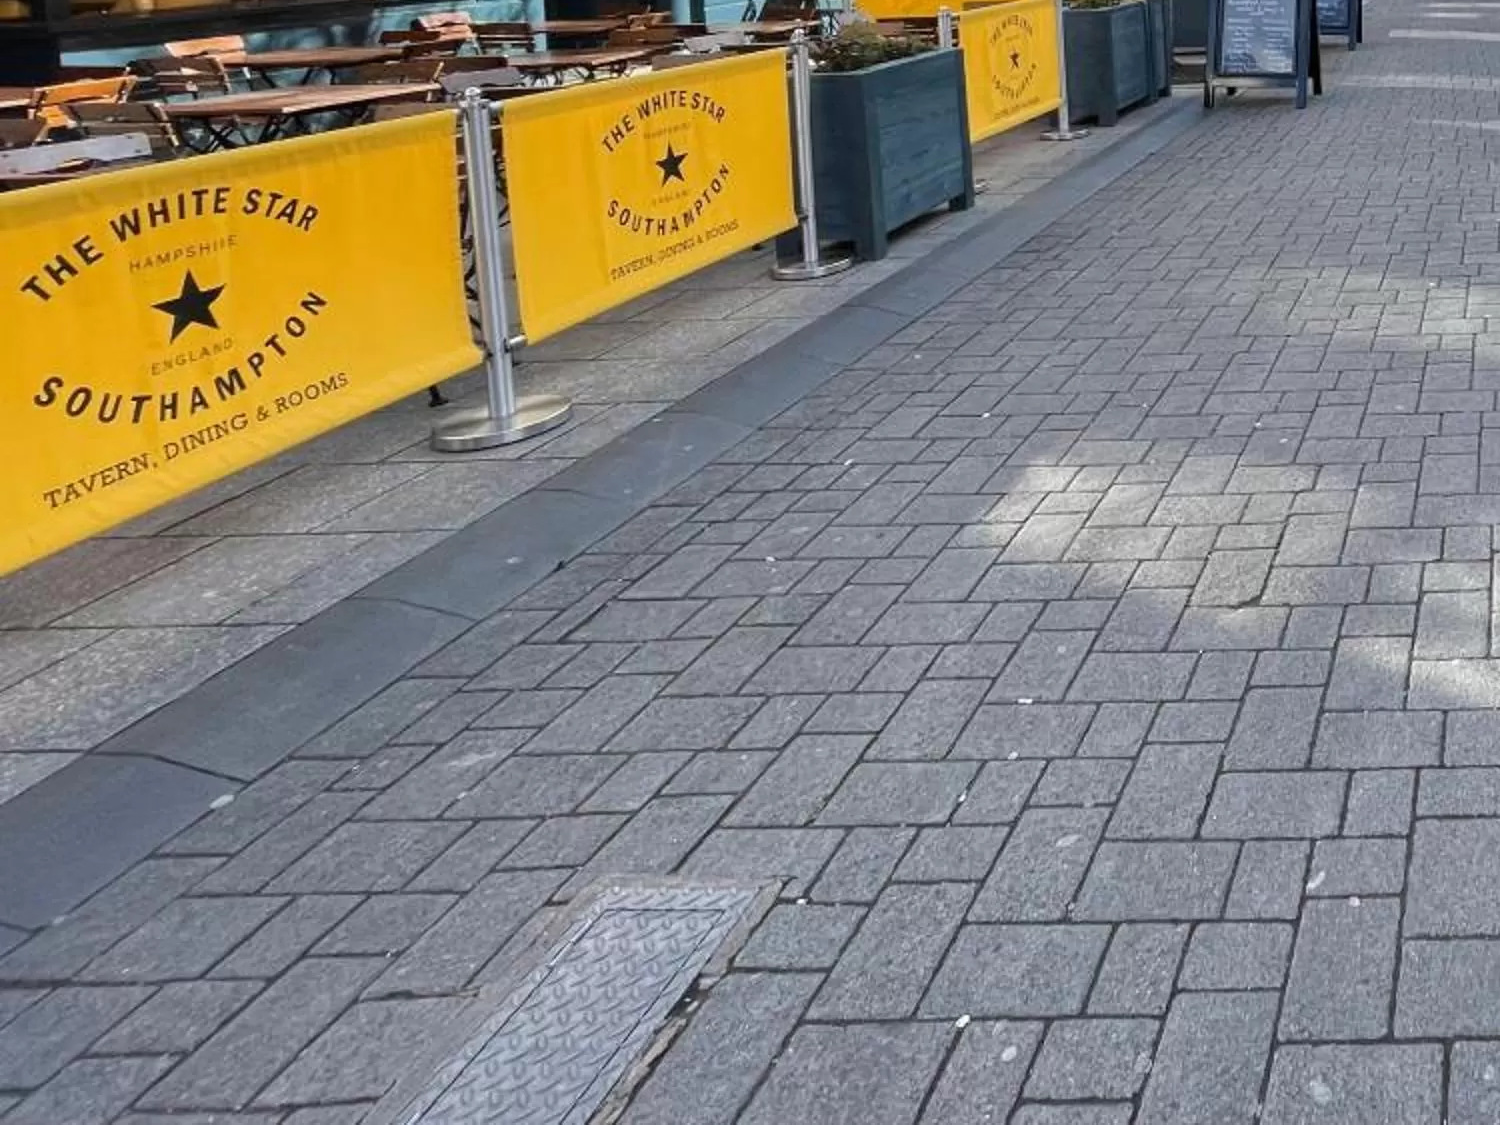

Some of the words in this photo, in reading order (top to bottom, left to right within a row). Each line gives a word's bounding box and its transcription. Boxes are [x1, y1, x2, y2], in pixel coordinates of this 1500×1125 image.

[601, 114, 636, 153] THE
[636, 90, 688, 120] WHITE
[691, 92, 727, 123] STAR
[608, 163, 730, 236] SOUTHAMPTON
[20, 235, 104, 302] THE
[110, 187, 232, 242] WHITE
[242, 188, 319, 231] STAR
[129, 234, 239, 274] HAMPSHIRE
[33, 291, 328, 424] SOUTHAMPTON
[151, 337, 234, 376] ENGLAND
[43, 452, 158, 509] TAVERN,
[163, 413, 249, 461] DINING
[255, 405, 271, 422] &
[274, 372, 350, 412] ROOMS
